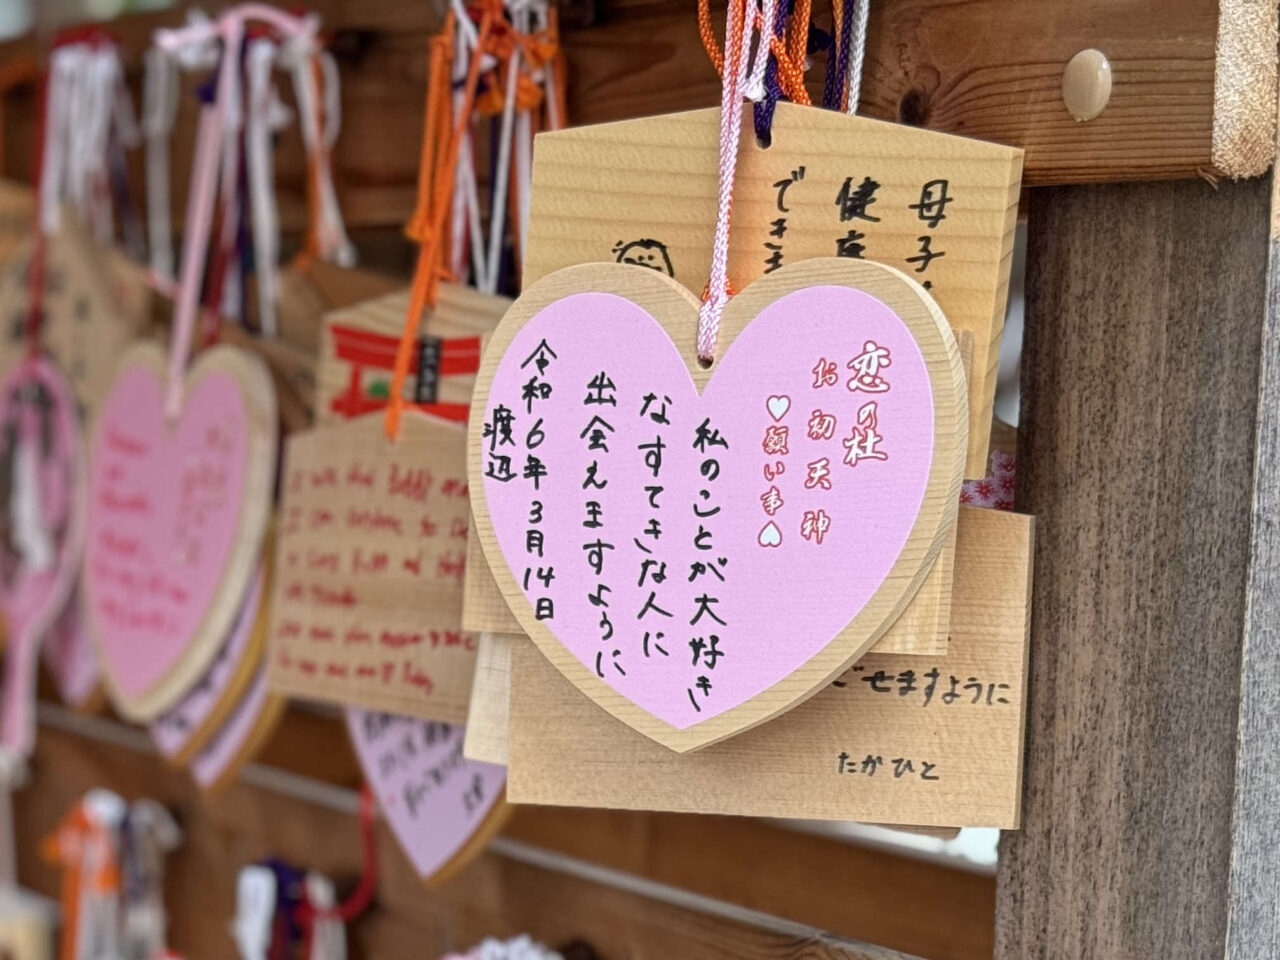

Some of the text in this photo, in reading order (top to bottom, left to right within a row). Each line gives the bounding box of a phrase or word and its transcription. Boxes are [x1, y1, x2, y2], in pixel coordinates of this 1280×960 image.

[482, 403, 518, 483] 渡辺
[520, 338, 558, 621] 令和6年3月14日
[579, 370, 627, 679] 出会えますように
[633, 392, 674, 658] なすてきな人に
[800, 357, 838, 545] お初天神
[842, 339, 892, 467] 恋の杜
[686, 417, 729, 713] 私のことが大好き
